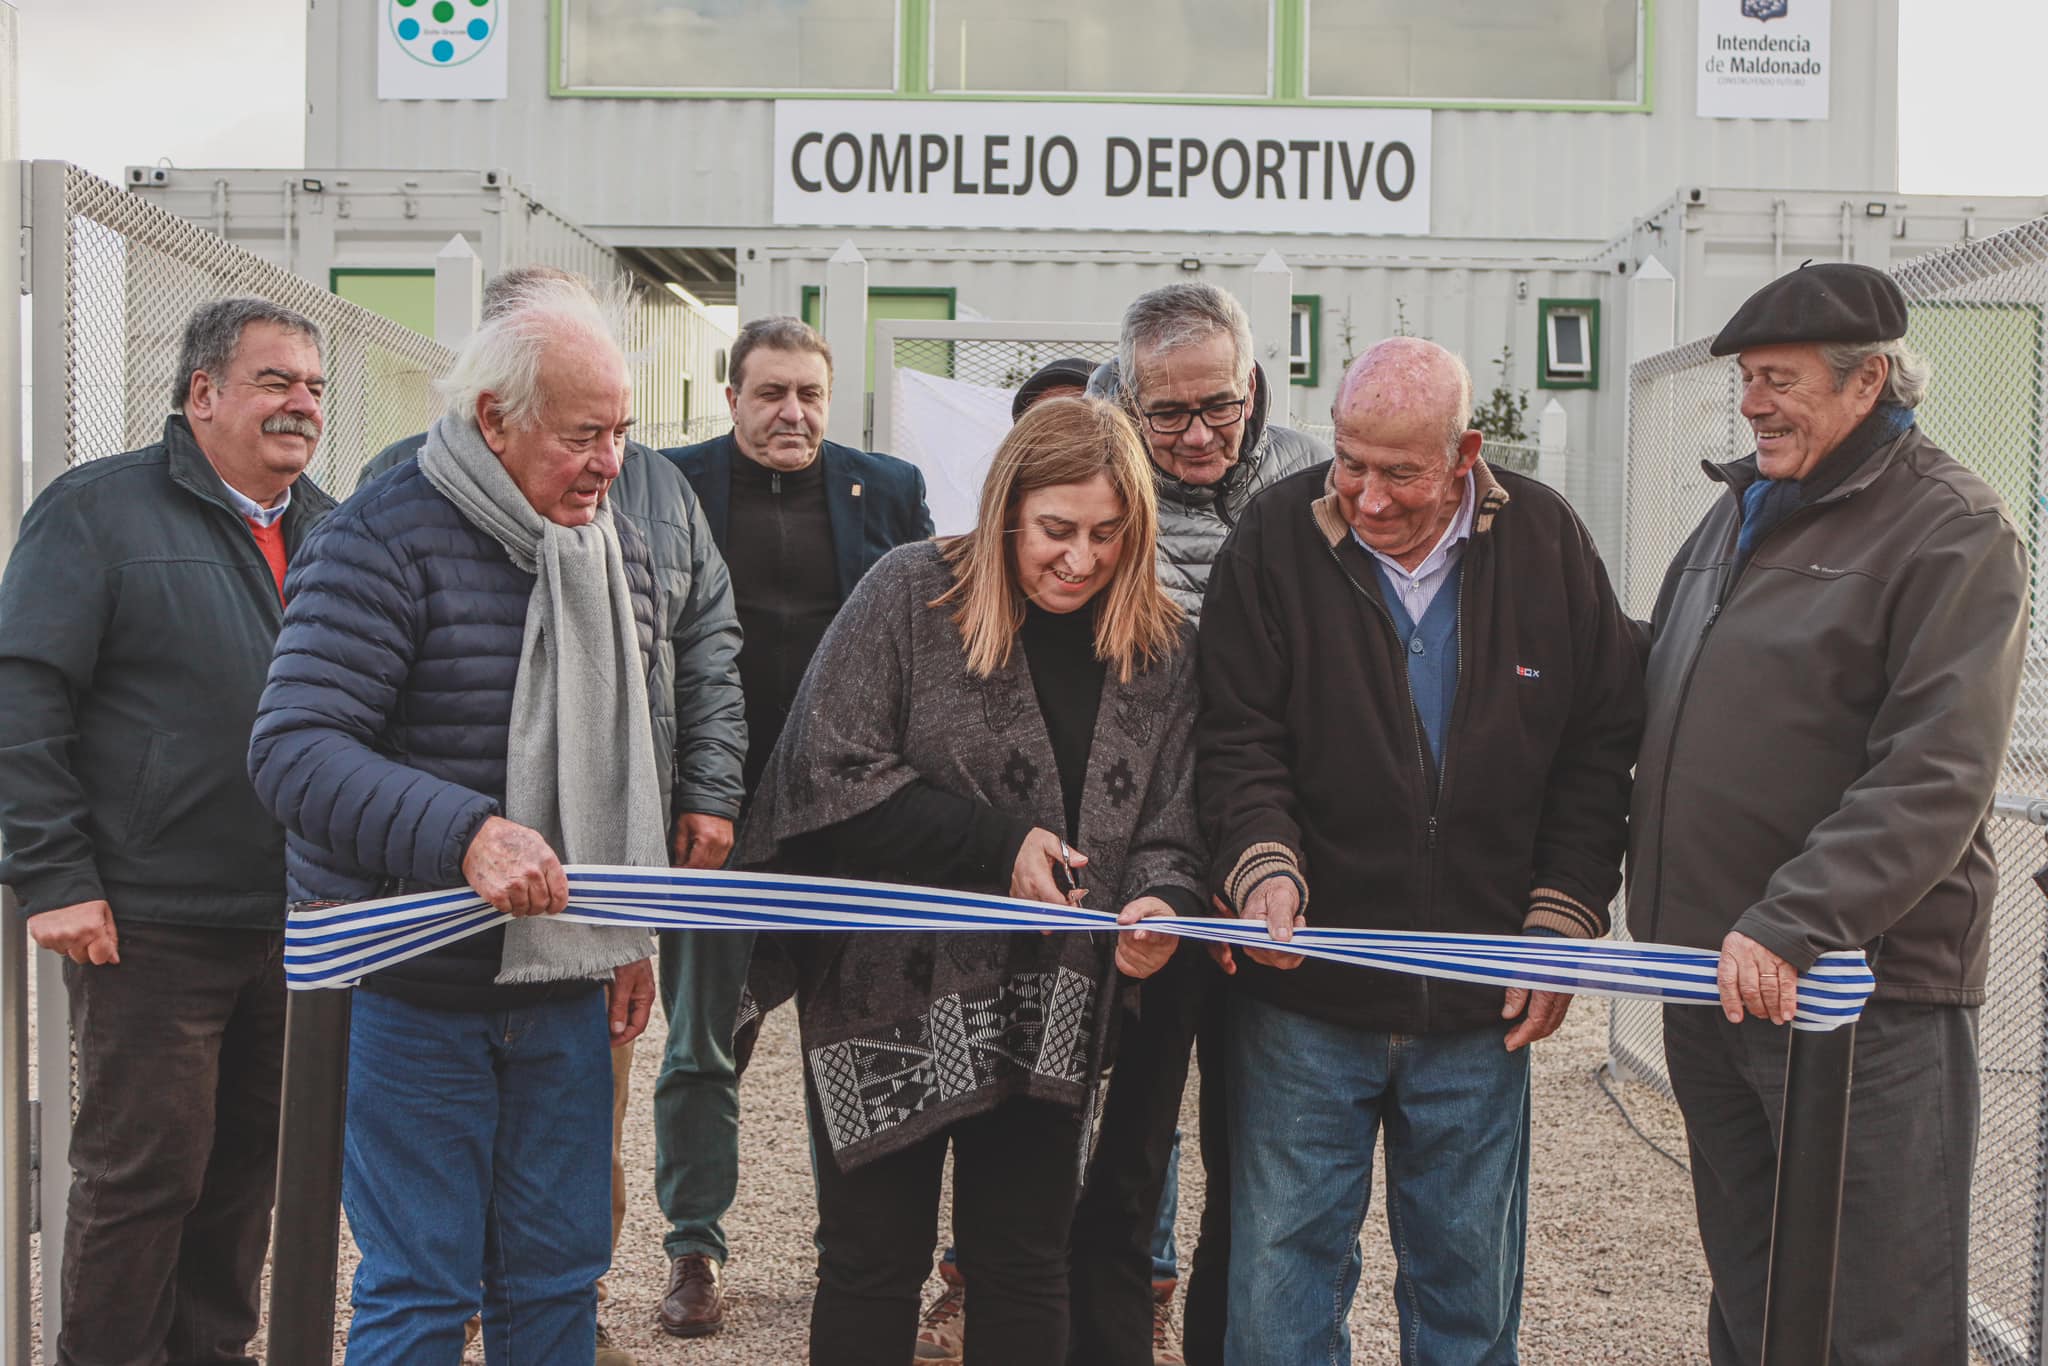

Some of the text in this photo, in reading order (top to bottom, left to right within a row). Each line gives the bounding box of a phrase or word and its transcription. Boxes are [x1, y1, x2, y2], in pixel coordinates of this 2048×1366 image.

[1717, 34, 1811, 53] Intendencia
[1705, 56, 1821, 75] de Maldonado
[791, 131, 1415, 202] COMPLEJO DEPORTIVO
